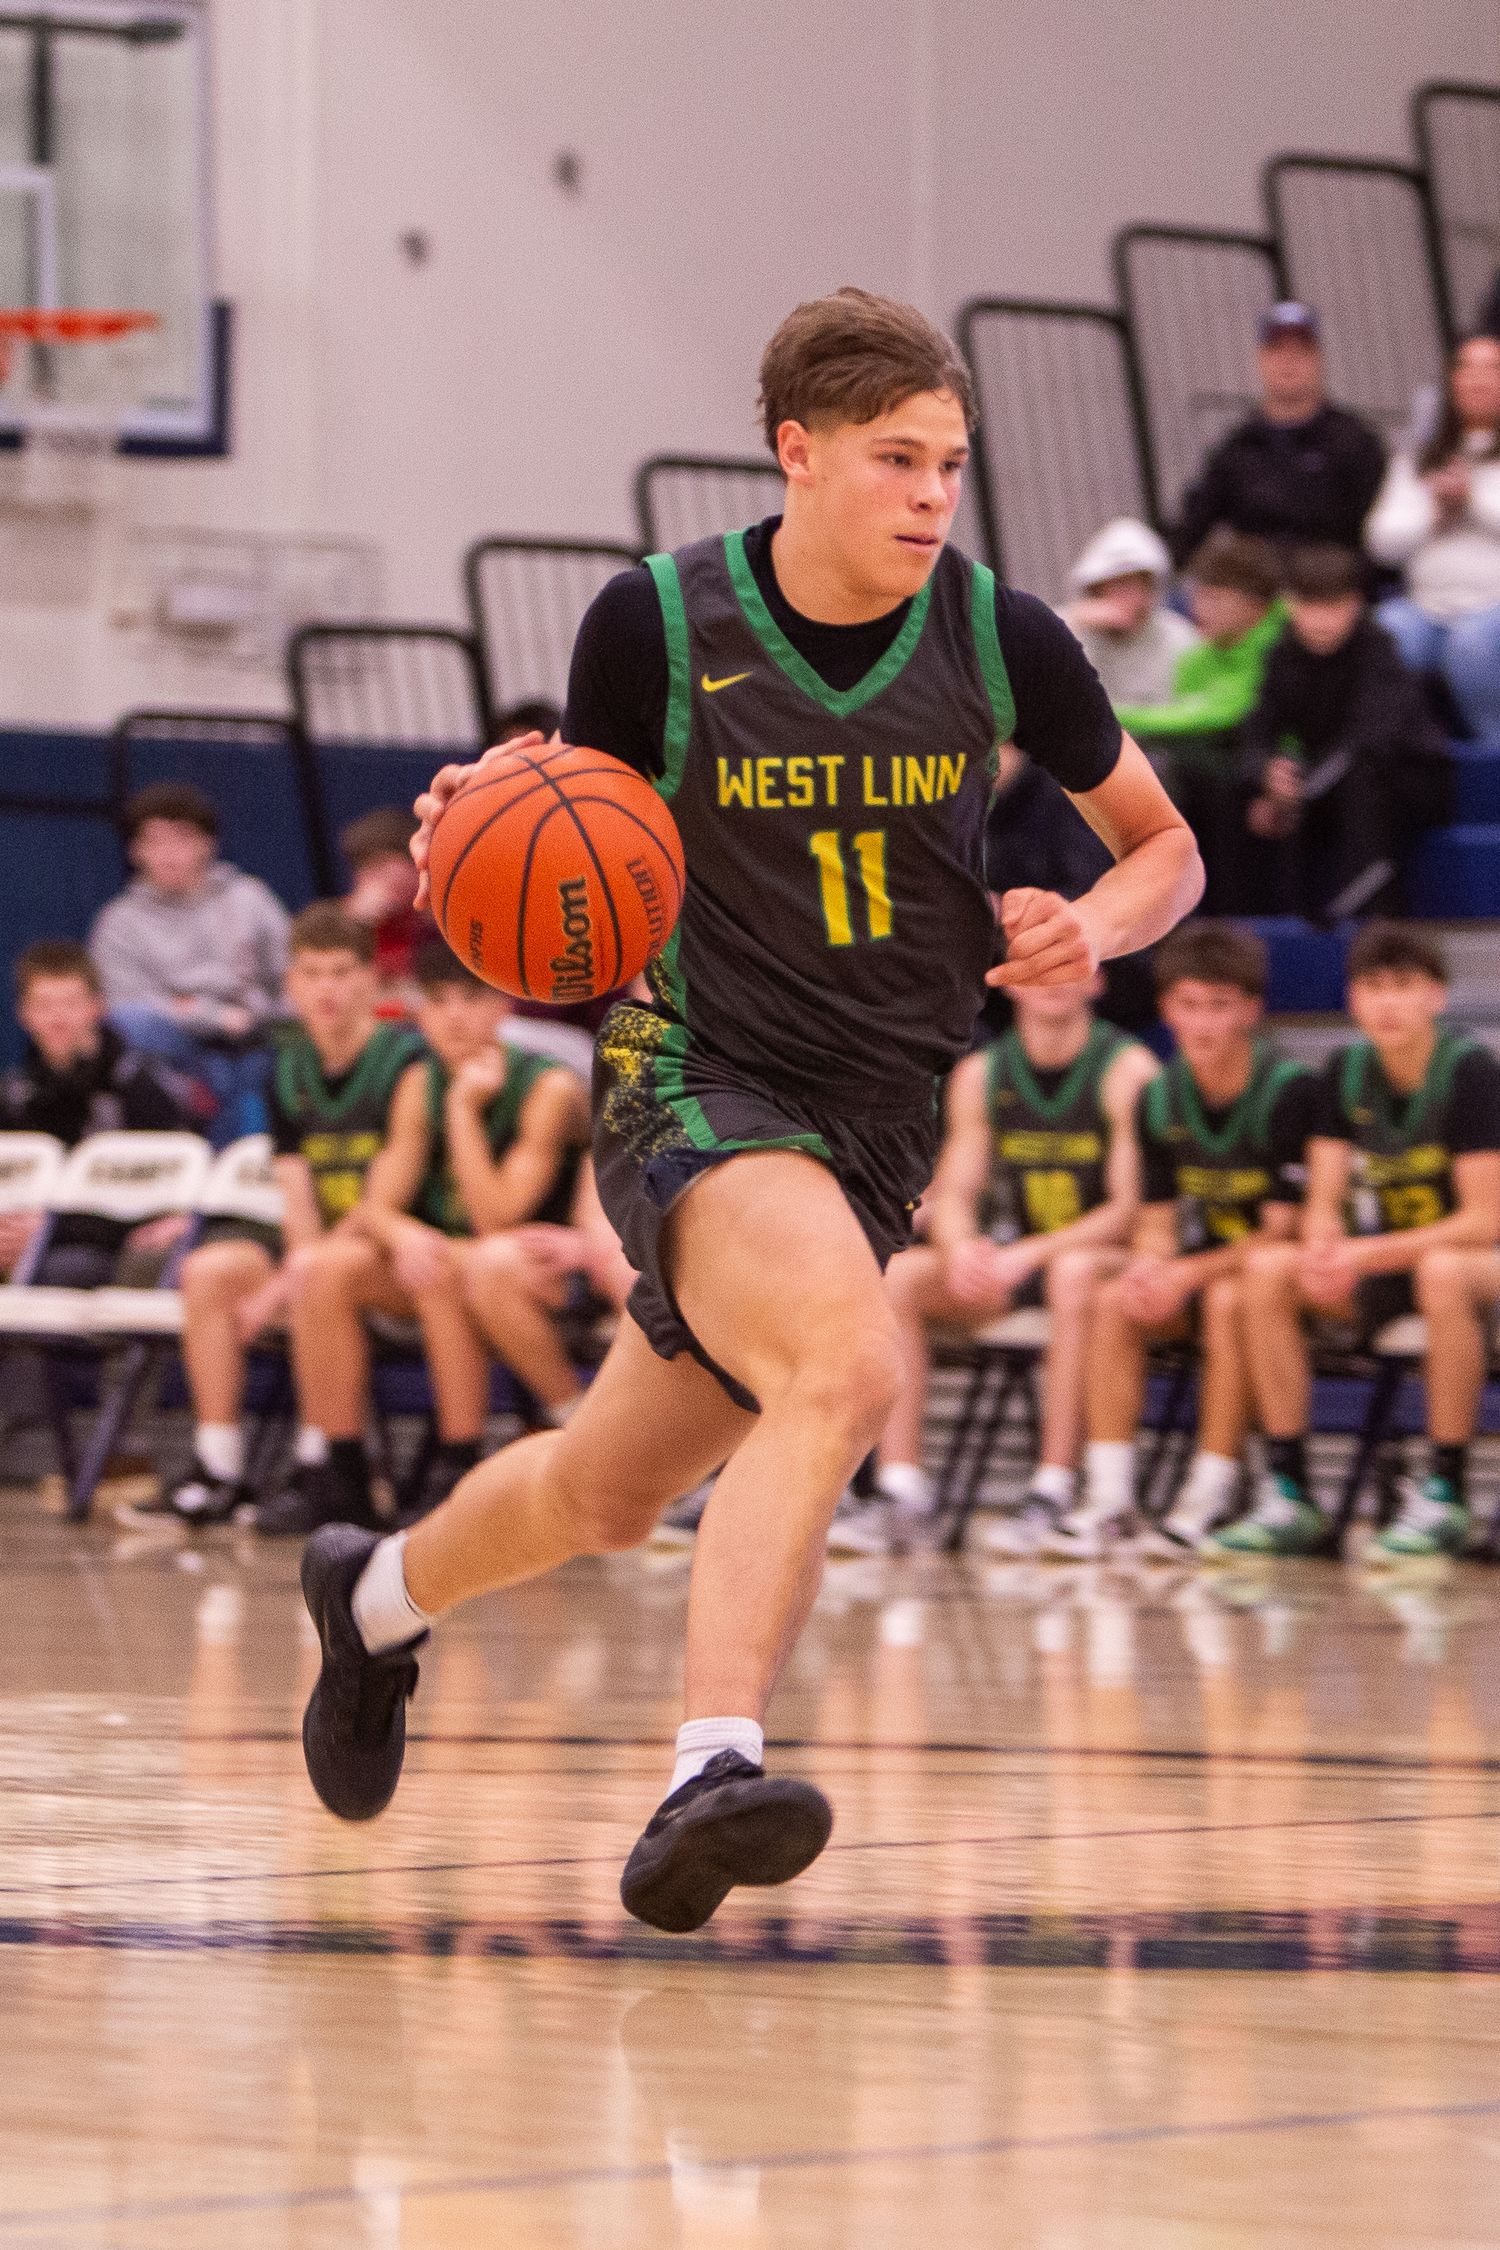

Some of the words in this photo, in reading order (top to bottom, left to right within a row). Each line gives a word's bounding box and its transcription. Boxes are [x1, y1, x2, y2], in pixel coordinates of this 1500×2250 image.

[716, 755, 845, 809] WEST
[863, 752, 967, 808] LINN
[809, 829, 894, 945] 11
